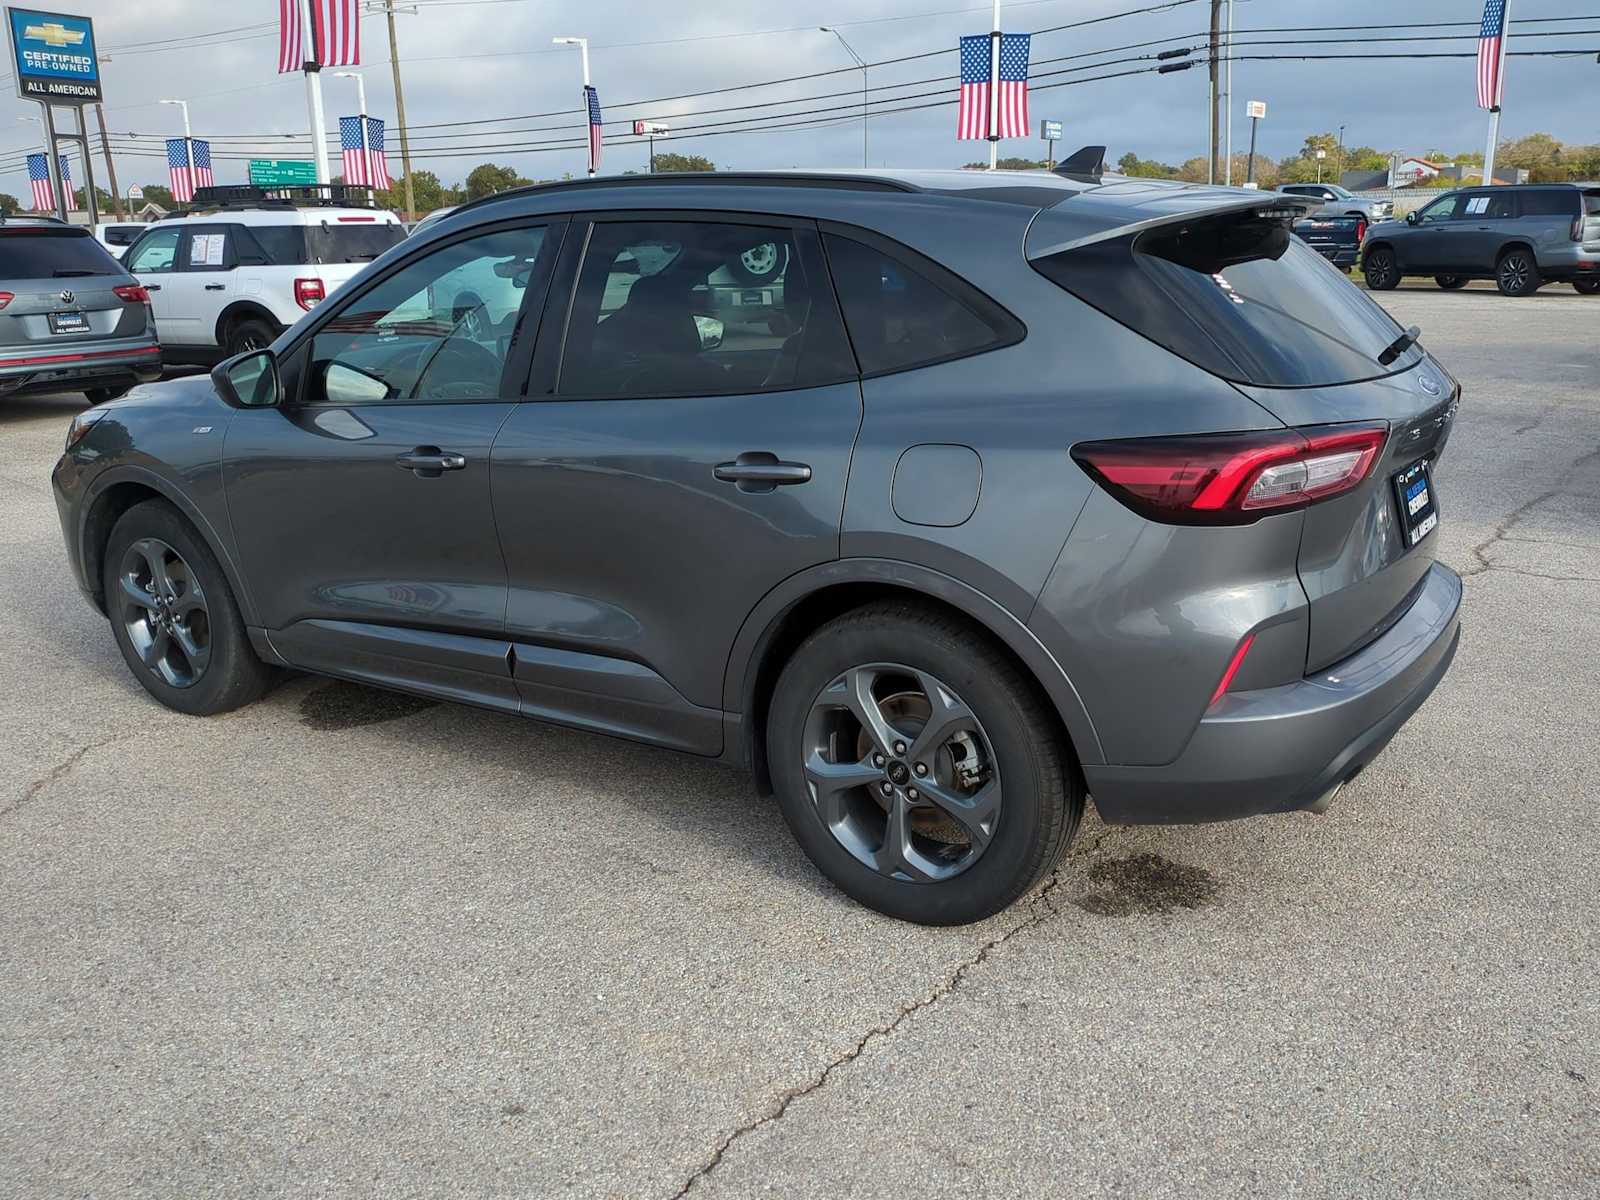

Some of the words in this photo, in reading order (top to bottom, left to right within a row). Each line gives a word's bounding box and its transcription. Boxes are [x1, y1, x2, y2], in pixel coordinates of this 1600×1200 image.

[23, 50, 92, 65] CERTIFIED
[27, 60, 91, 73] PRE-OWNED
[27, 81, 46, 93] ALL
[48, 83, 97, 96] AMERICAN
